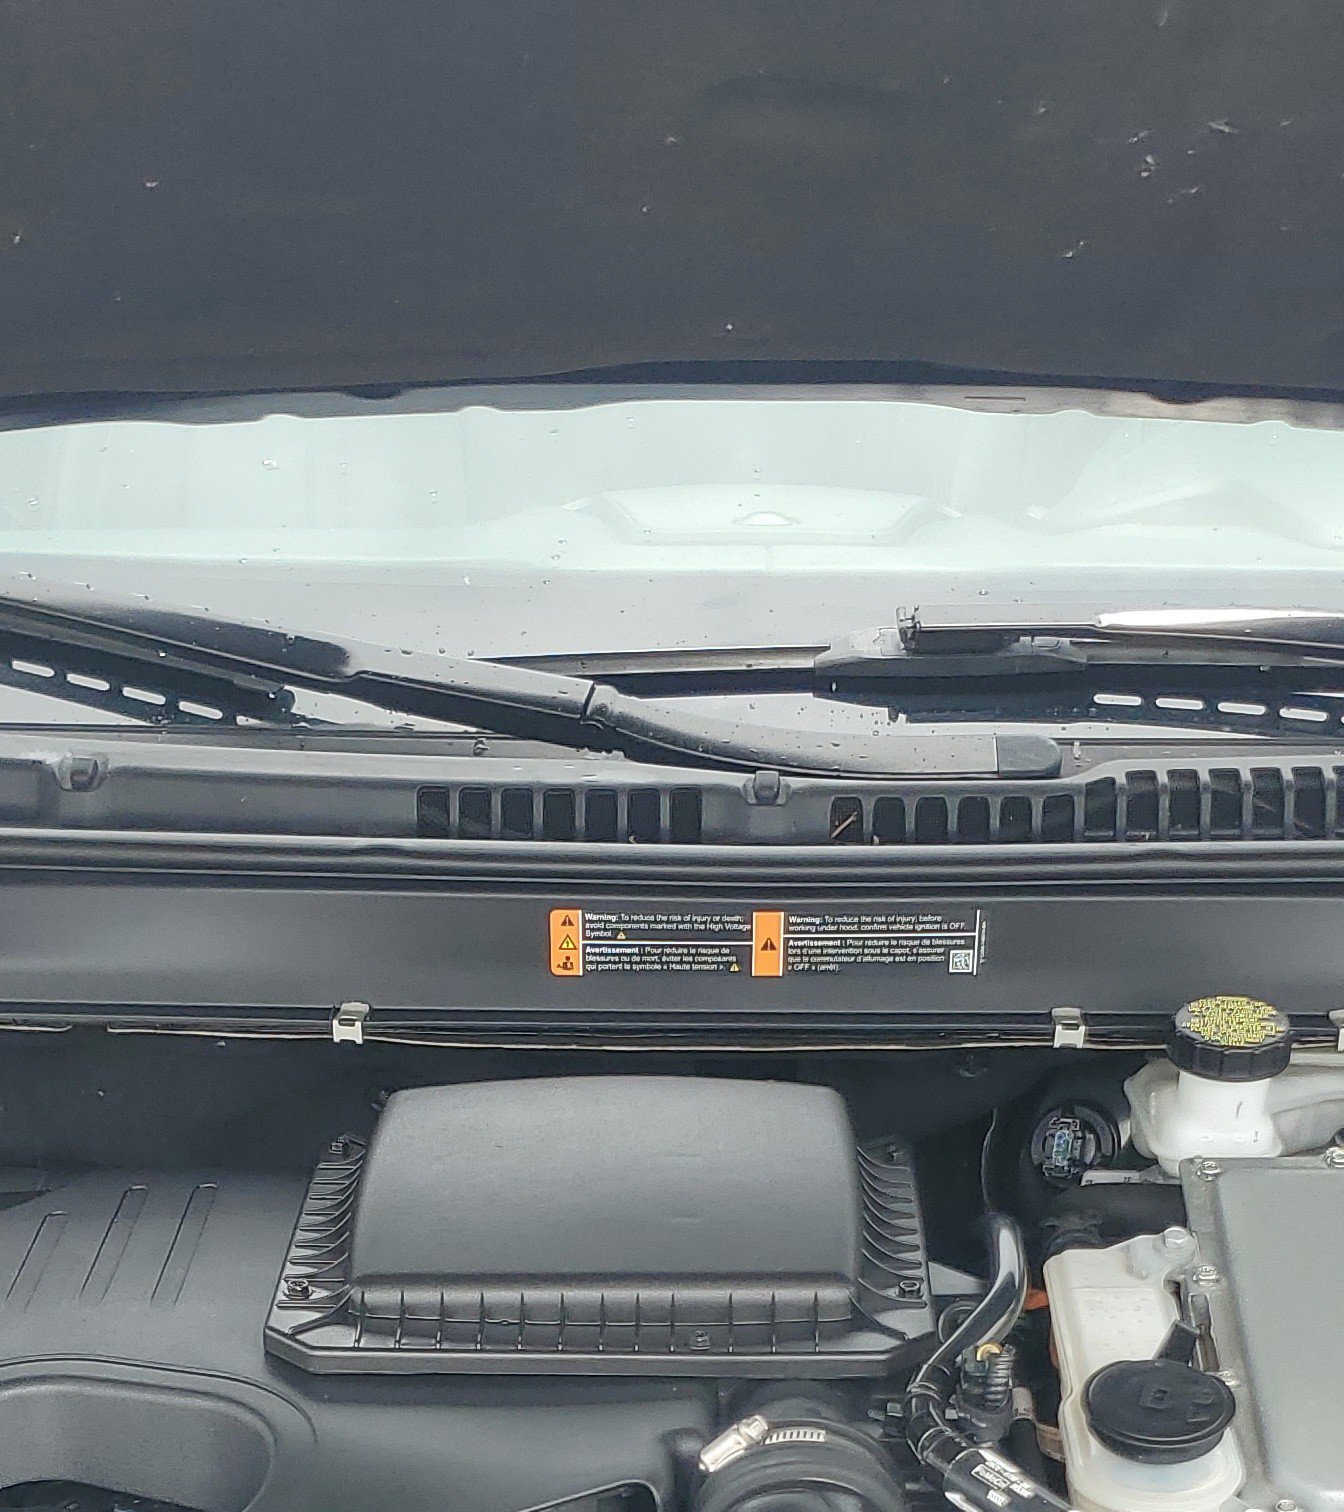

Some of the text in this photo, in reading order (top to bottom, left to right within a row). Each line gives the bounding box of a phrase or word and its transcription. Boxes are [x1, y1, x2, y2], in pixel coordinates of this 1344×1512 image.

[585, 913, 619, 922] Warning:
[631, 913, 655, 922] reduce
[656, 913, 668, 922] the
[669, 913, 682, 922] risk
[788, 915, 823, 924] Warning:
[834, 915, 859, 923] reduce
[860, 915, 872, 923] the
[873, 915, 886, 923] risk
[707, 923, 724, 932] High
[725, 923, 752, 932] Voltage
